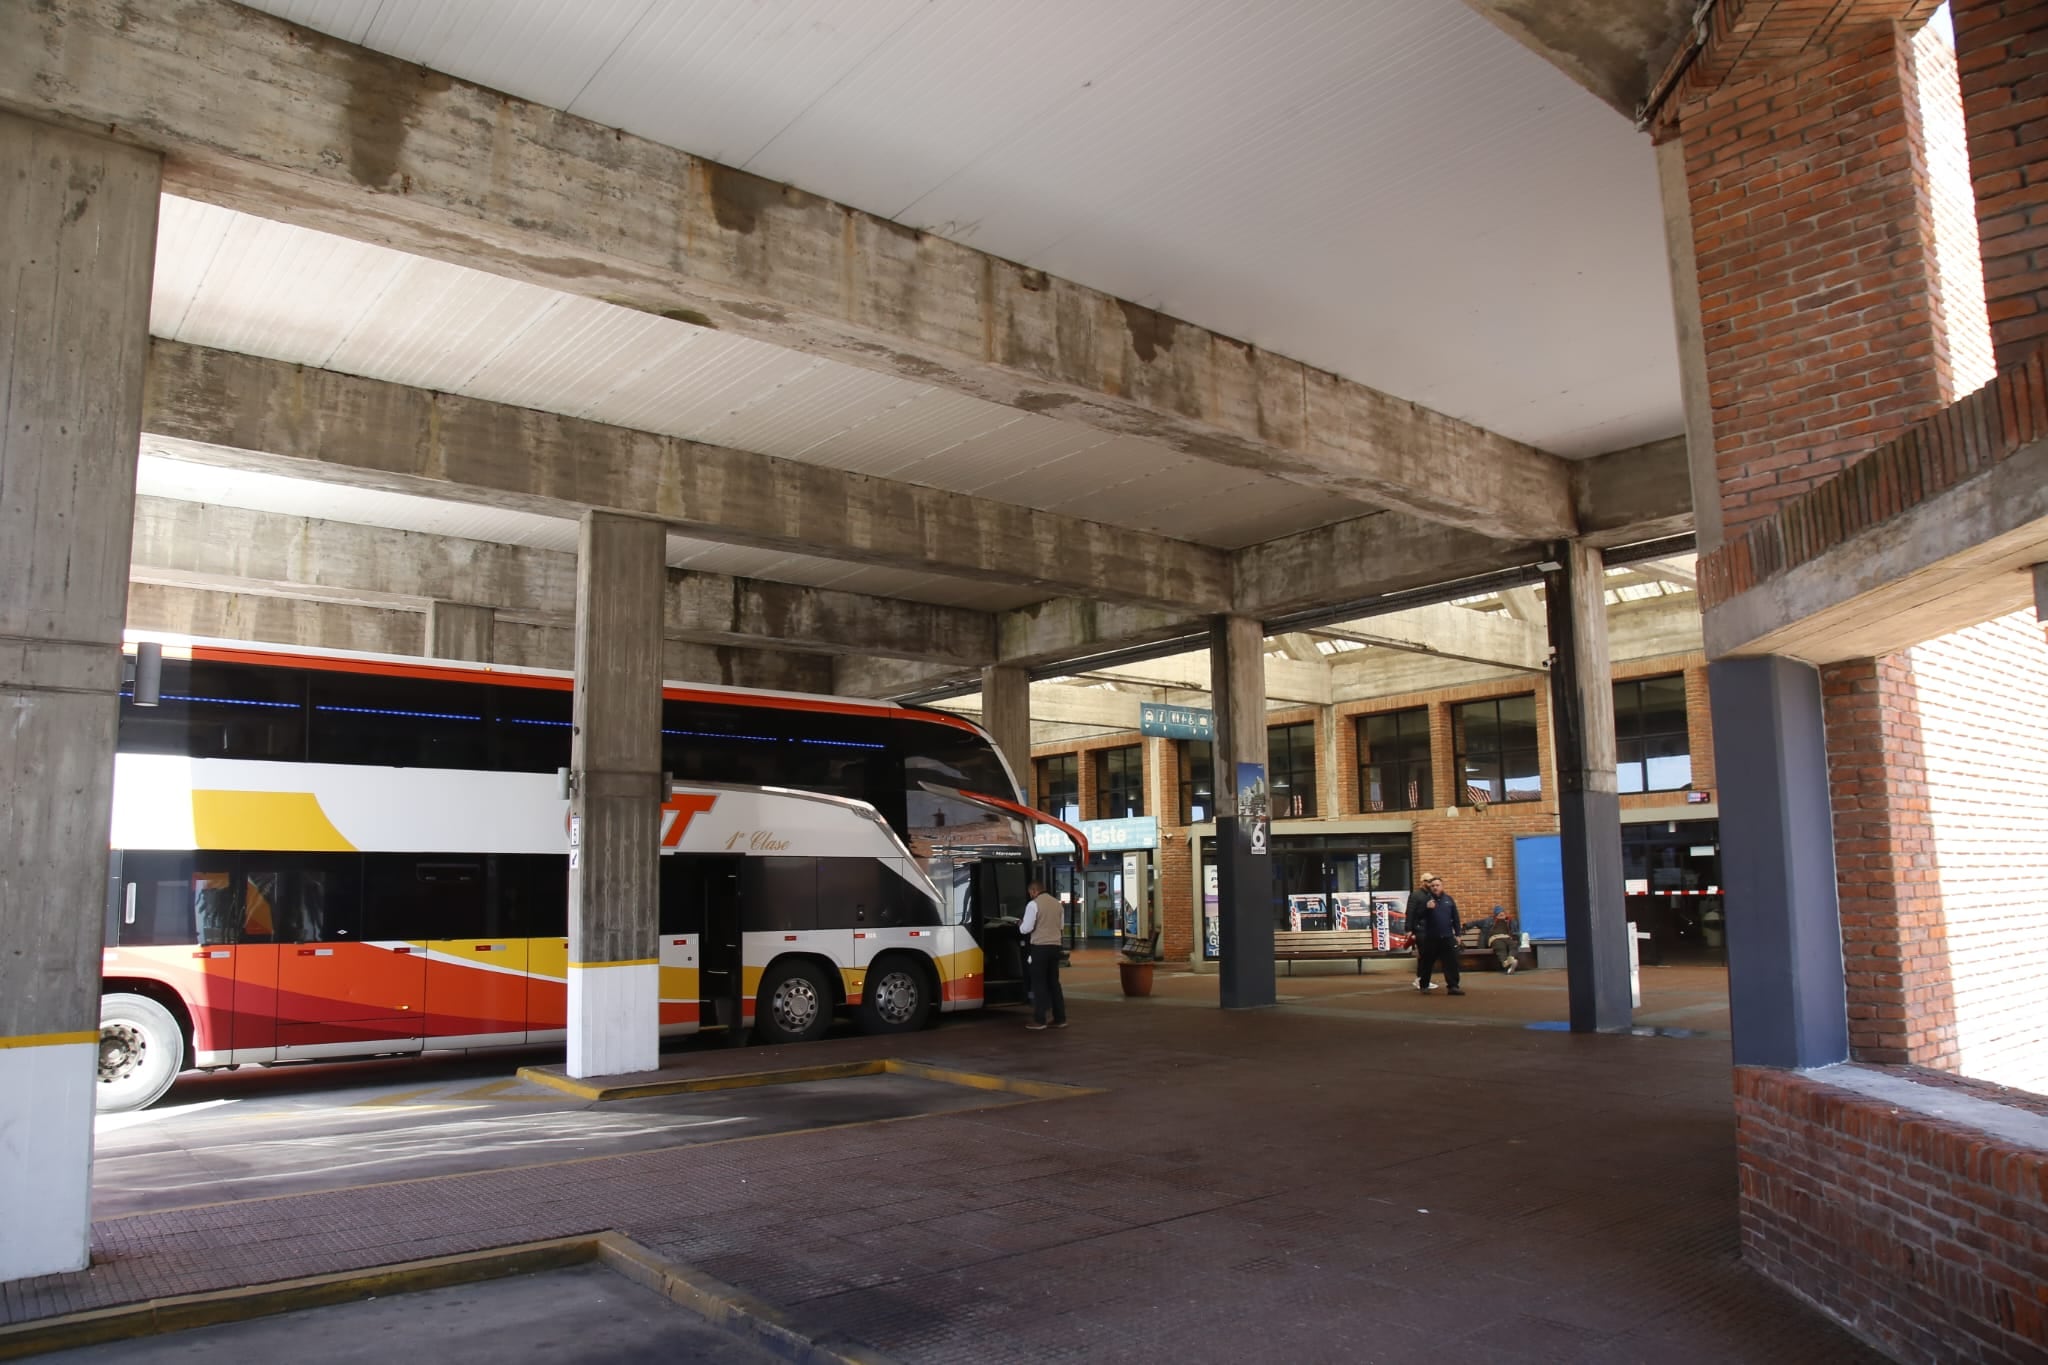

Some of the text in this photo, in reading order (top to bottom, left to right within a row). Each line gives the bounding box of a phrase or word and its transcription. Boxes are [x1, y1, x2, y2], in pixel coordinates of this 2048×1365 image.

[751, 830, 790, 851] Clase
[1035, 827, 1060, 847] nta
[1091, 825, 1127, 844] Este
[1252, 822, 1265, 848] 6
